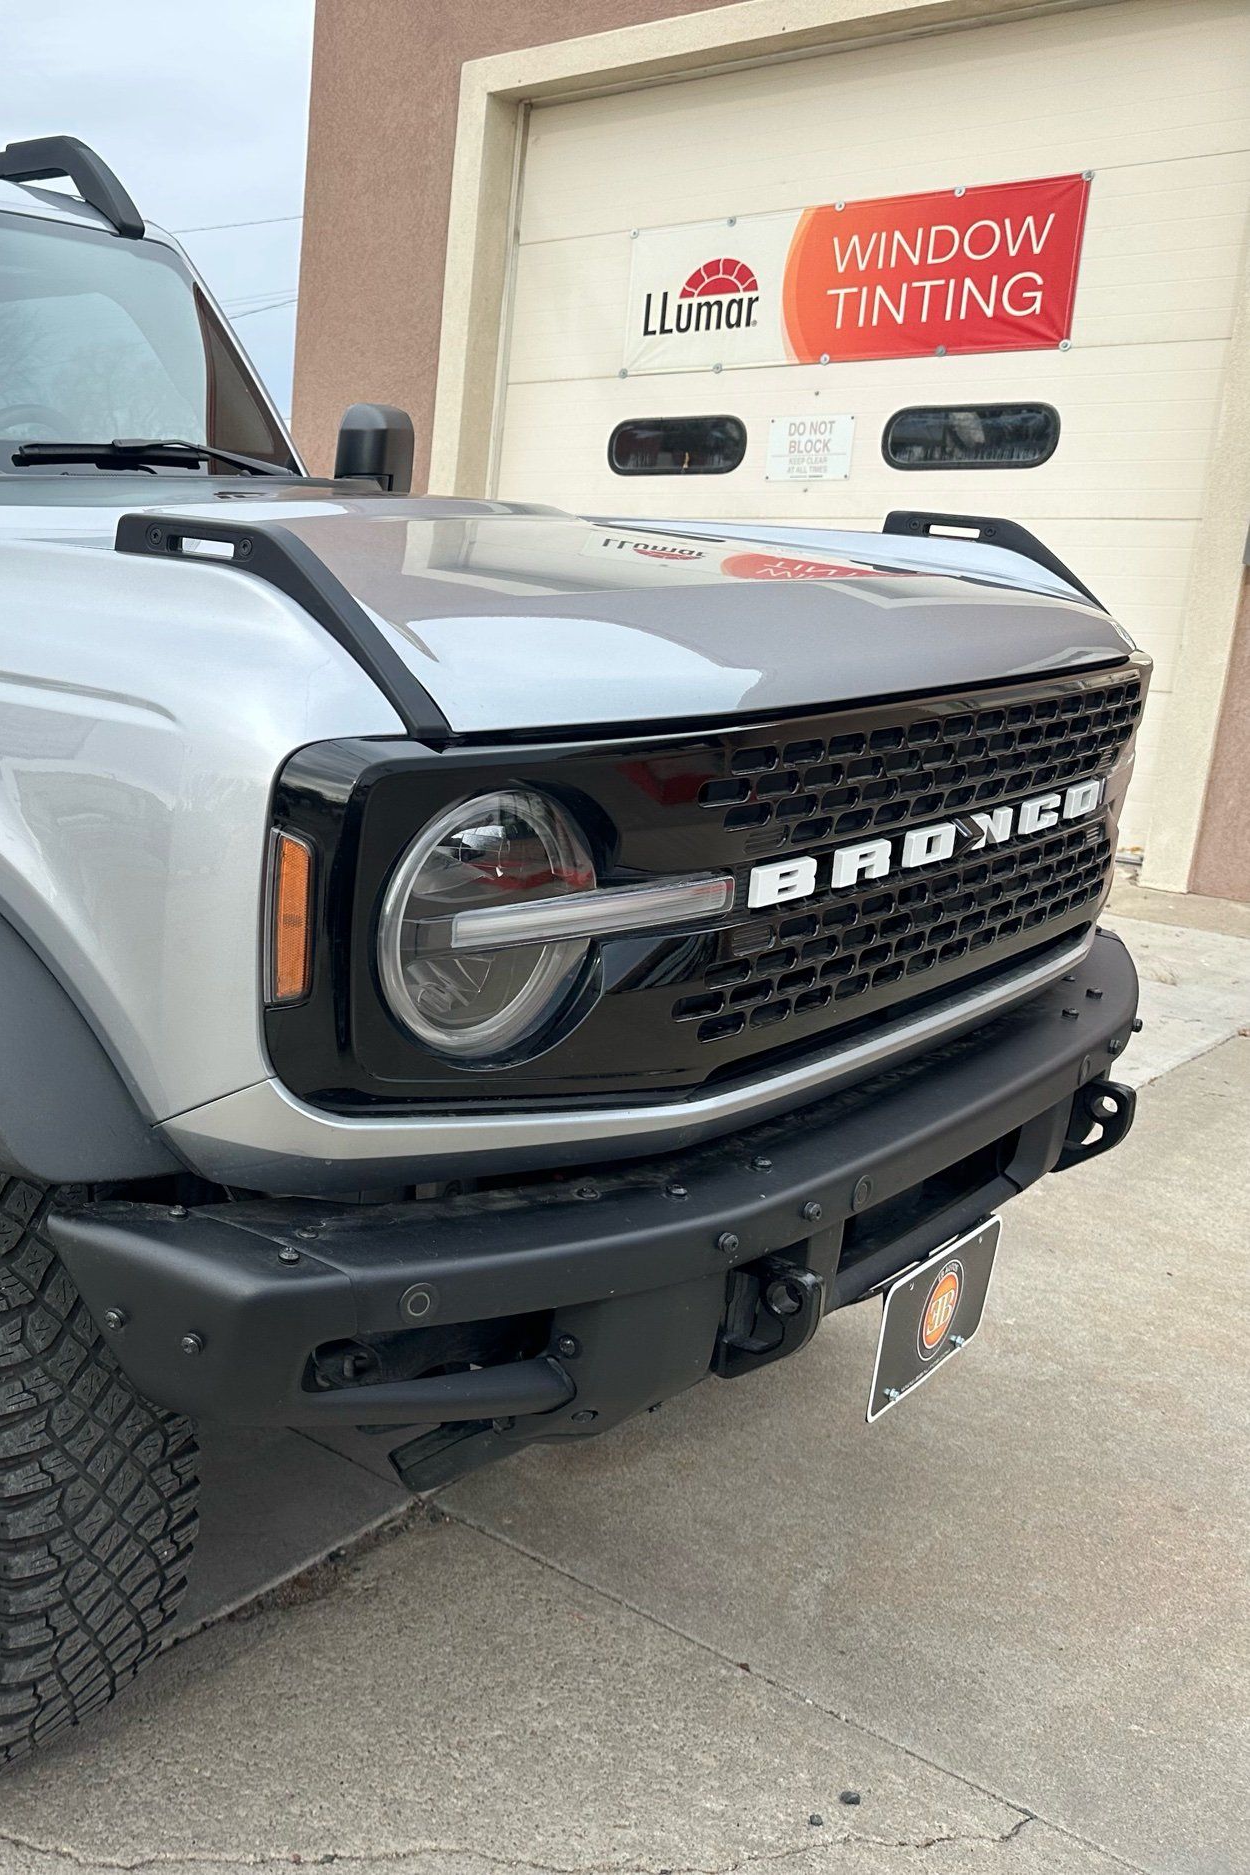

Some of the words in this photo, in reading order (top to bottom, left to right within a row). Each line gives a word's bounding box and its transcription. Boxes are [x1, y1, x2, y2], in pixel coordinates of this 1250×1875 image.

[833, 213, 1055, 273] WINDOW
[643, 292, 759, 336] LLumar
[826, 271, 1044, 329] TINTING
[788, 422, 806, 436] DO
[809, 420, 836, 435] NOT
[788, 439, 831, 454] BLOCK
[789, 457, 805, 465] KEEP
[806, 456, 828, 464] CLEAR
[747, 779, 1101, 909] BRONCO
